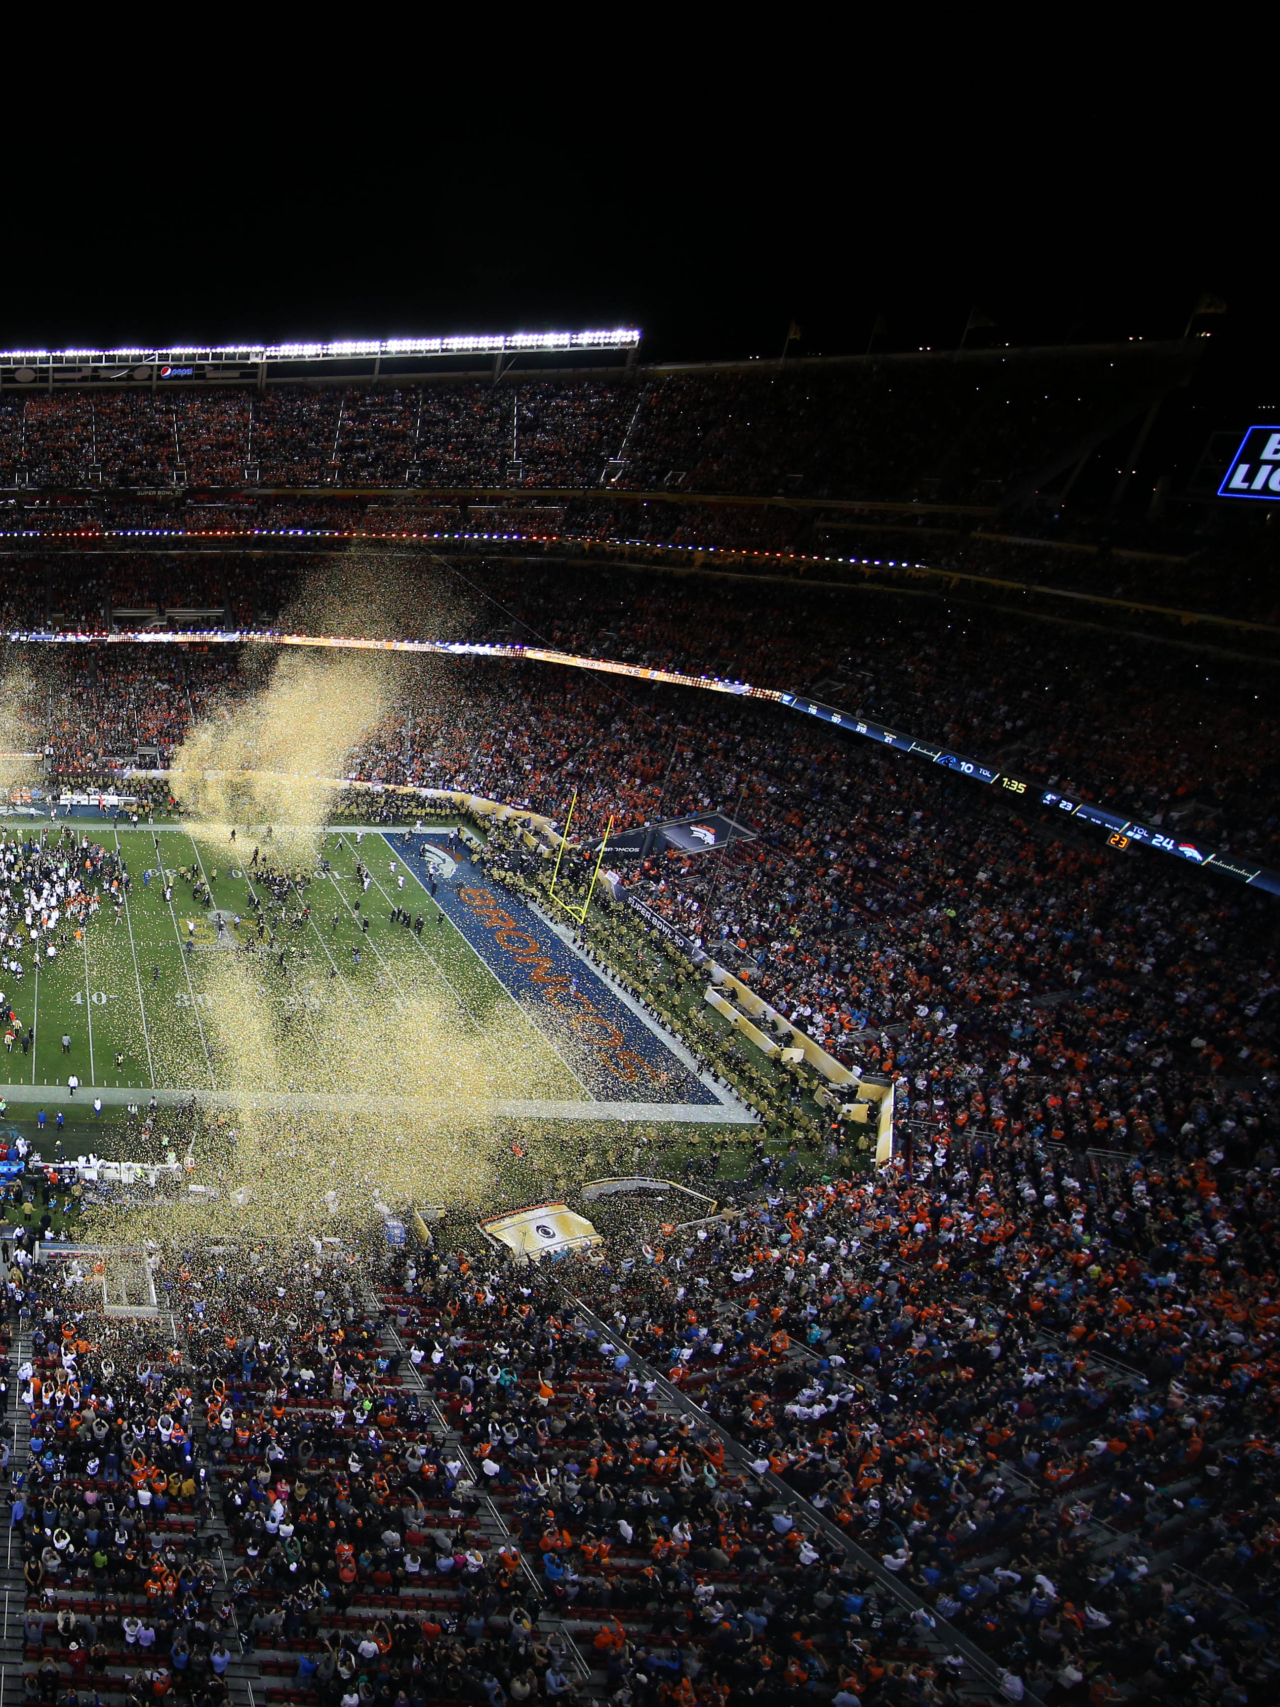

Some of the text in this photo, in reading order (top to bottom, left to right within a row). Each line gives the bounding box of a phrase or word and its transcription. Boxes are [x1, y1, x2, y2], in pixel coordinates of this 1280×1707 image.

[171, 367, 193, 377] pepsi
[960, 761, 974, 773] 10
[979, 768, 991, 777] TOL
[1002, 777, 1027, 794] 1:35
[1059, 800, 1074, 811] 23
[1133, 825, 1149, 838] TOL
[1109, 834, 1128, 849] 23
[1151, 833, 1175, 850] 24
[628, 896, 685, 947] SUPER BOWL 50
[459, 887, 658, 1083] BRONCOS
[70, 991, 108, 1006] 40
